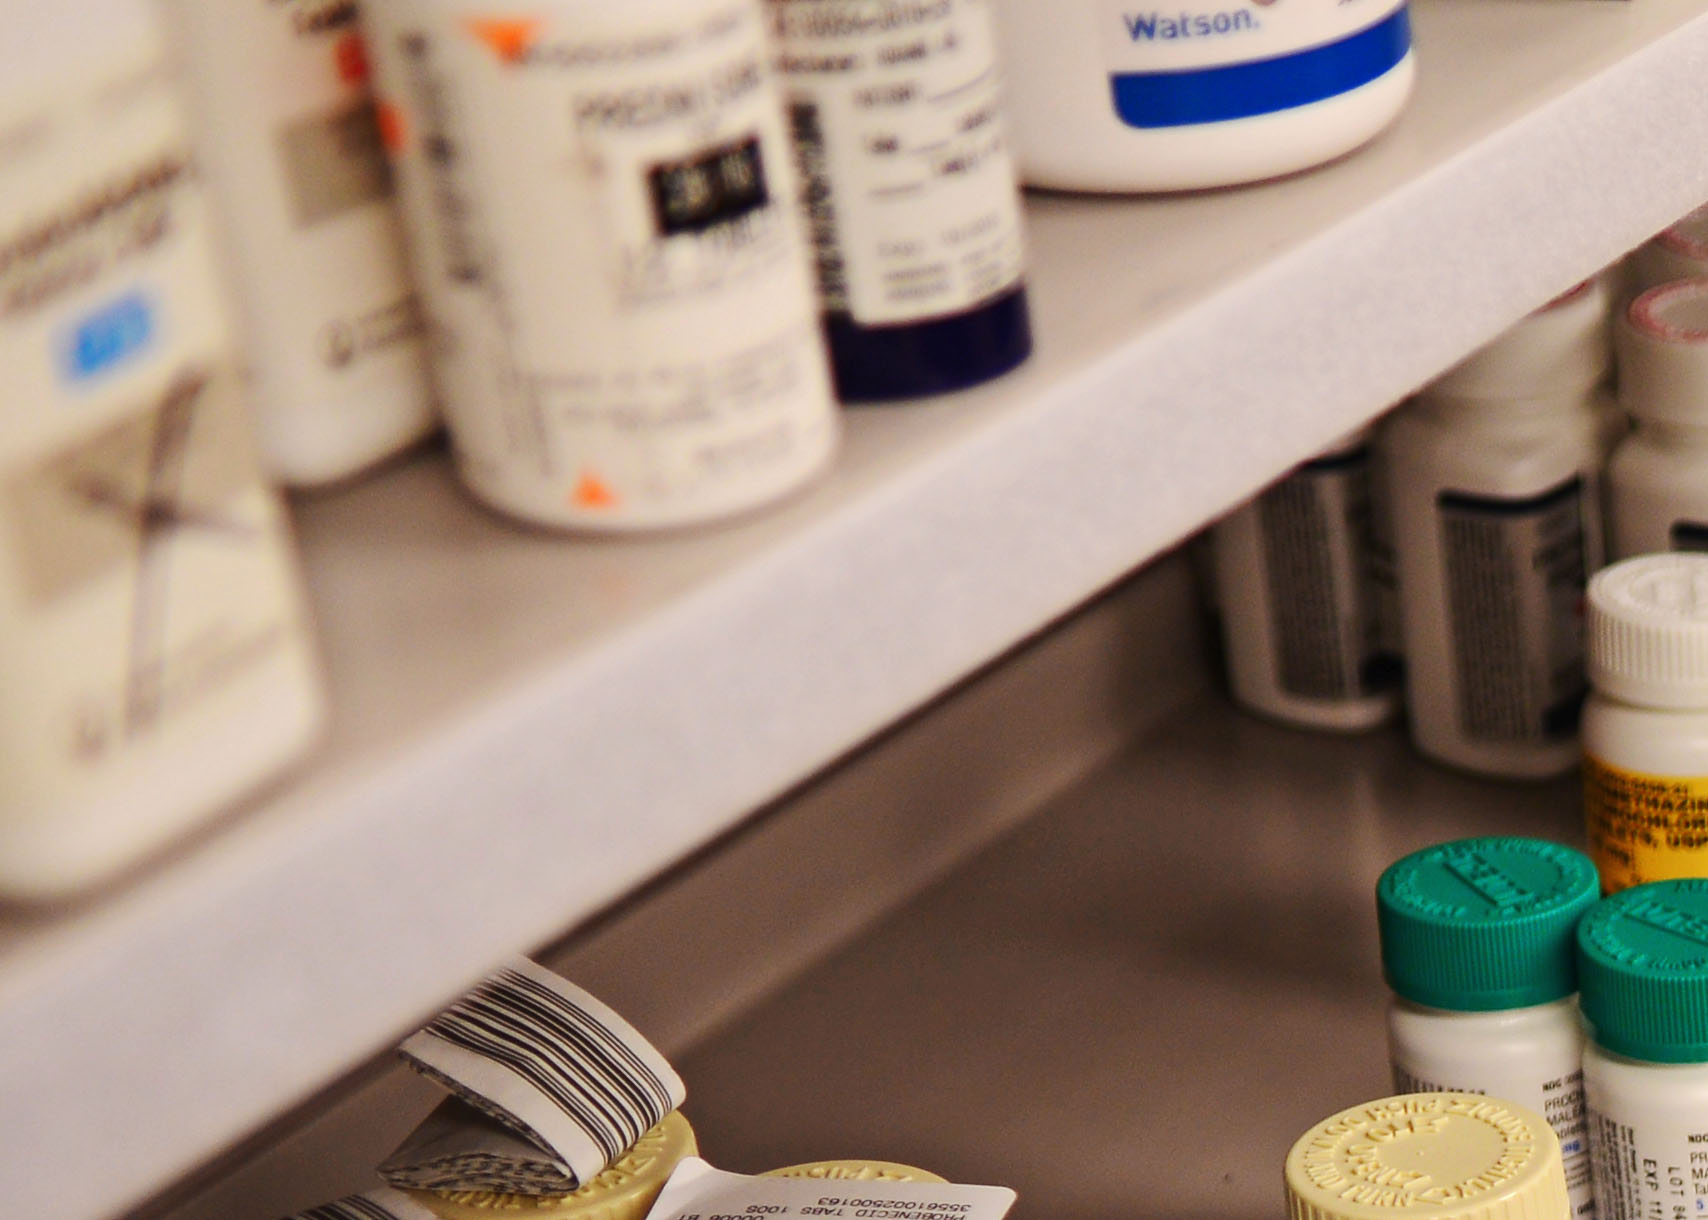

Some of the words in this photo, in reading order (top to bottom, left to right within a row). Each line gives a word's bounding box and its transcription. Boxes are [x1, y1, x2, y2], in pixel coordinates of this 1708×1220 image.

[1643, 1158, 1660, 1192] EXP
[1667, 1165, 1684, 1197] LOT
[800, 1205, 845, 1217] TABS
[817, 1197, 972, 1212] 35561002500163
